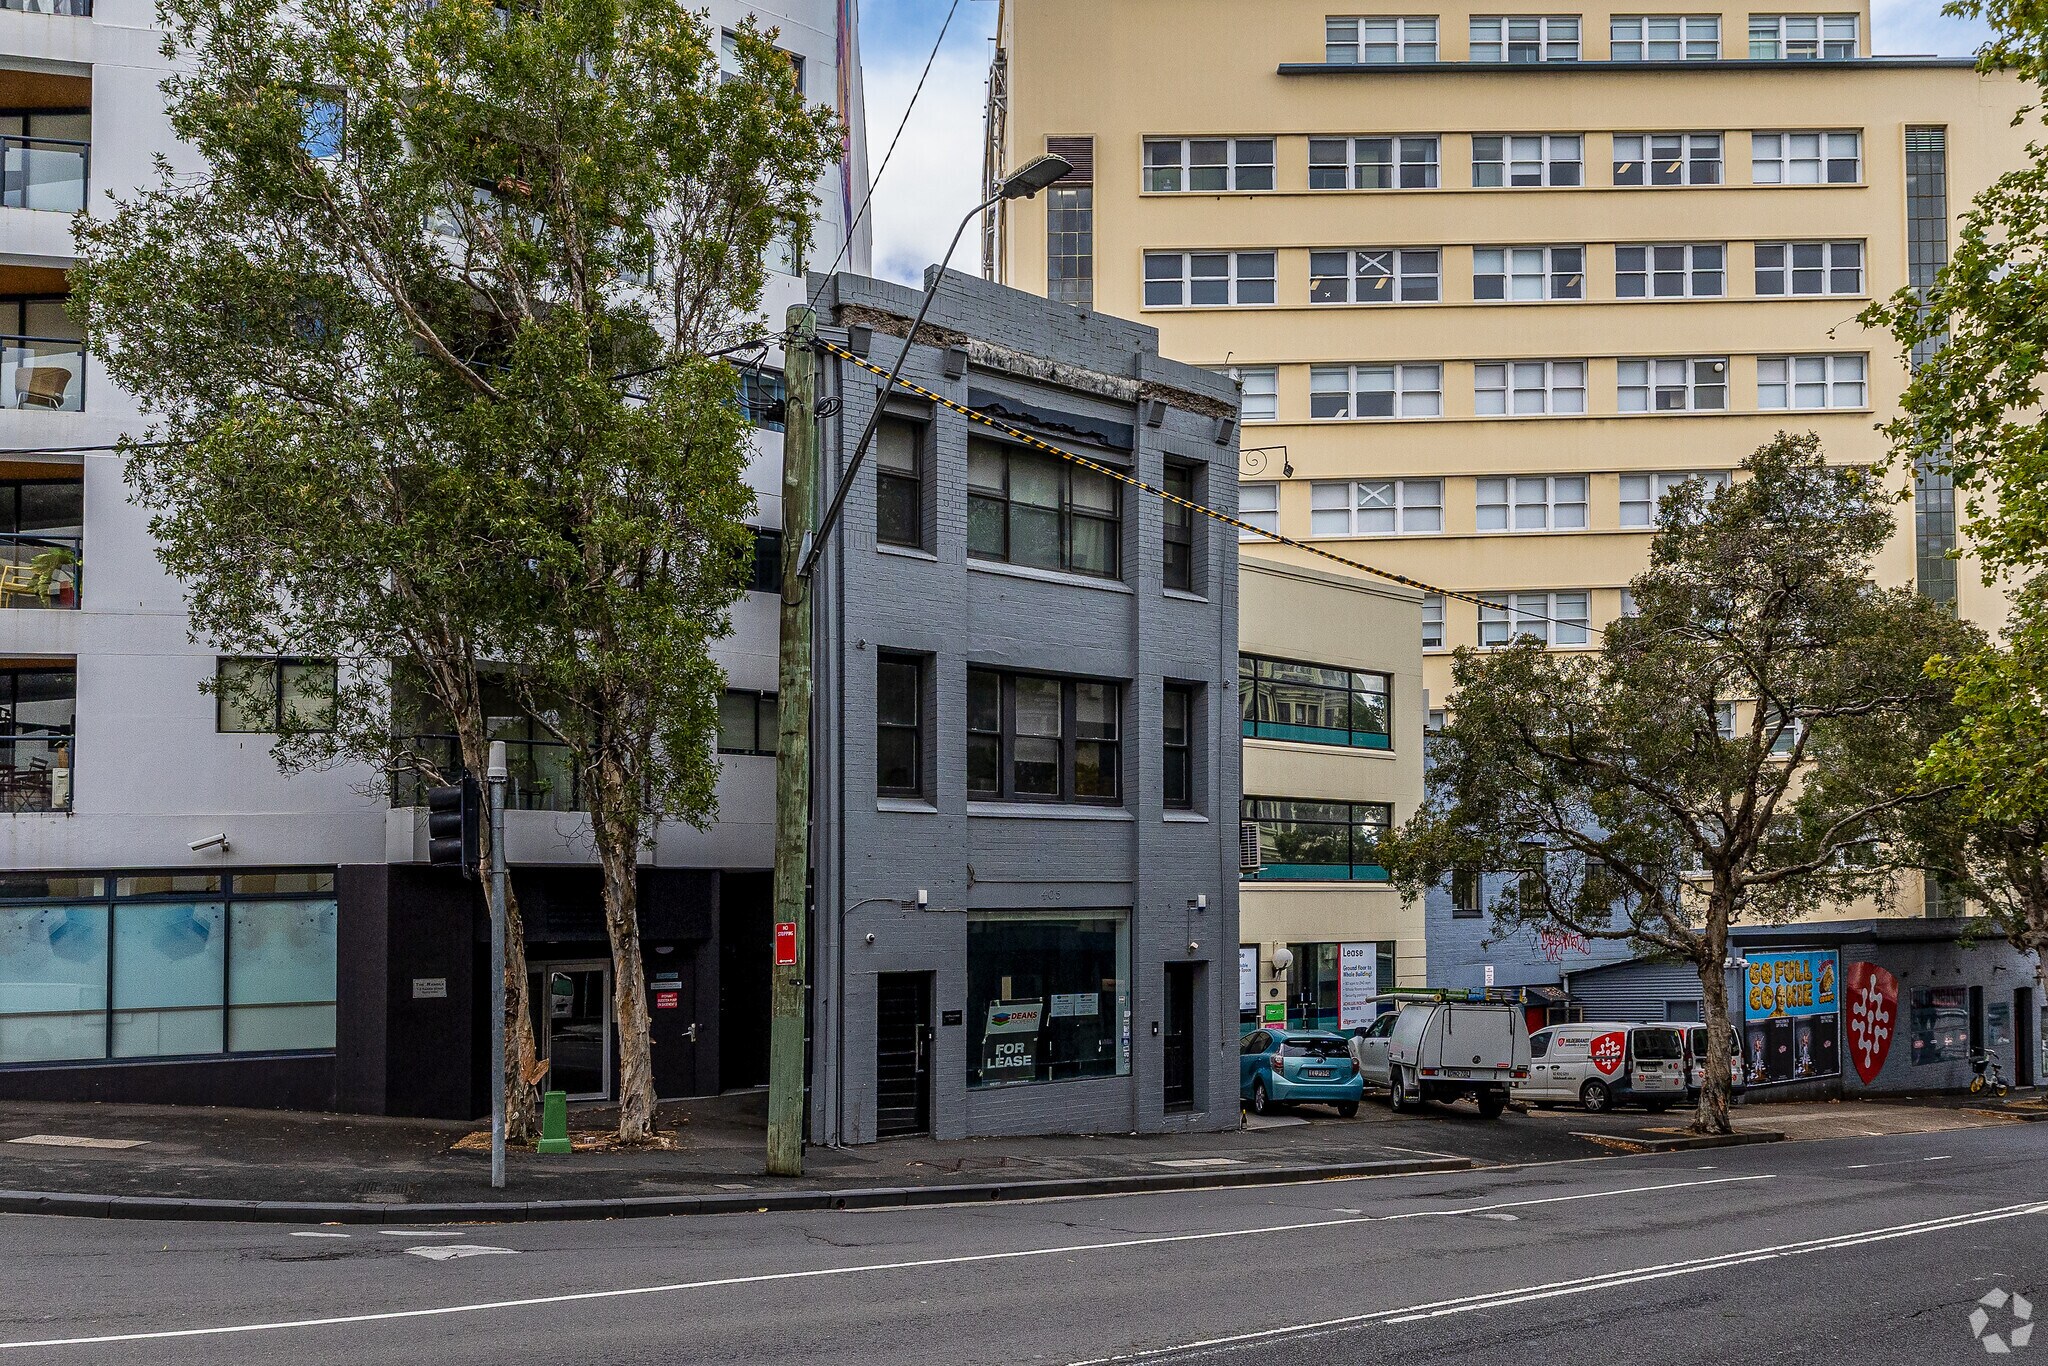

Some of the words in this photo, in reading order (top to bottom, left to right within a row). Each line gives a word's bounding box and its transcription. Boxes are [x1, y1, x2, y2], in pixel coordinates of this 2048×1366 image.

[1041, 890, 1061, 900] 405
[1343, 948, 1364, 957] Lease
[1749, 962, 1772, 985] GO
[1774, 960, 1812, 983] FULL
[1012, 1012, 1038, 1020] DEANS
[996, 1042, 1025, 1055] FOR
[987, 1055, 1032, 1068] LEASE
